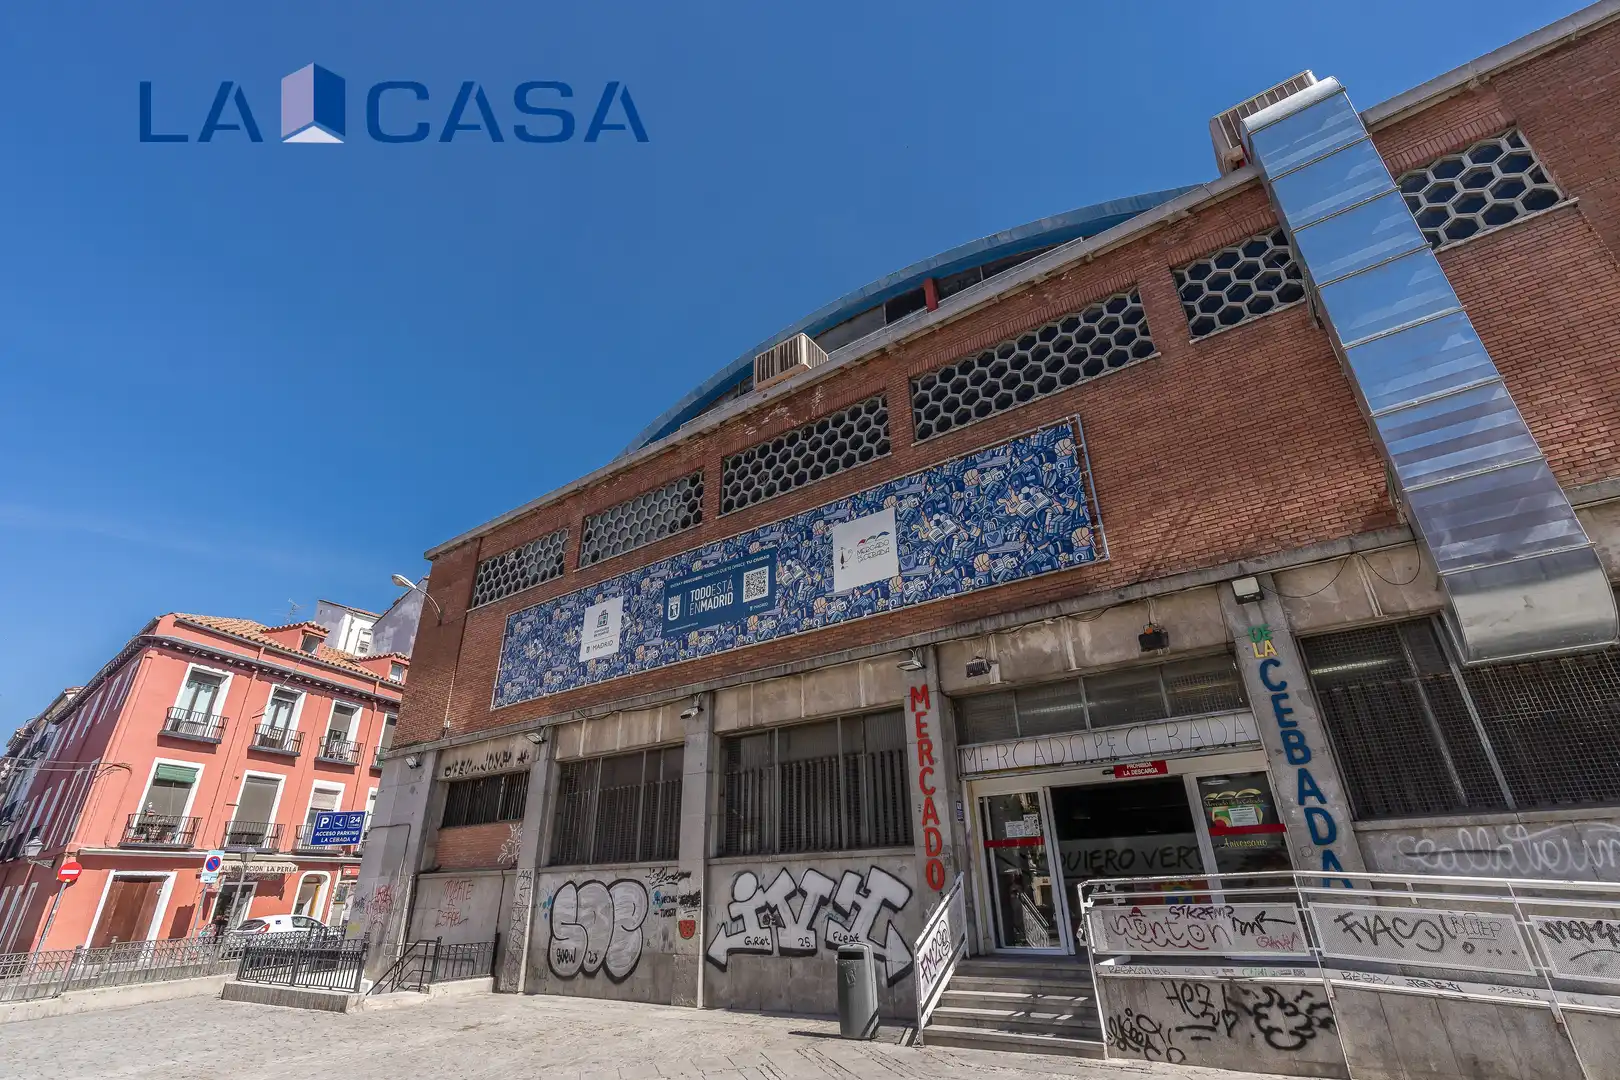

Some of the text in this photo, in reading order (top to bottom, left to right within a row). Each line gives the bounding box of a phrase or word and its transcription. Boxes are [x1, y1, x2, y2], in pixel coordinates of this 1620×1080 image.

[1249, 624, 1273, 643] DE
[592, 640, 614, 651] MADRID
[1252, 639, 1278, 659] LA
[1131, 767, 1159, 776] DESCARGA
[1259, 658, 1354, 889] CEBADA
[910, 684, 946, 892] MERCADO
[320, 817, 329, 828] P
[350, 816, 361, 824] 24
